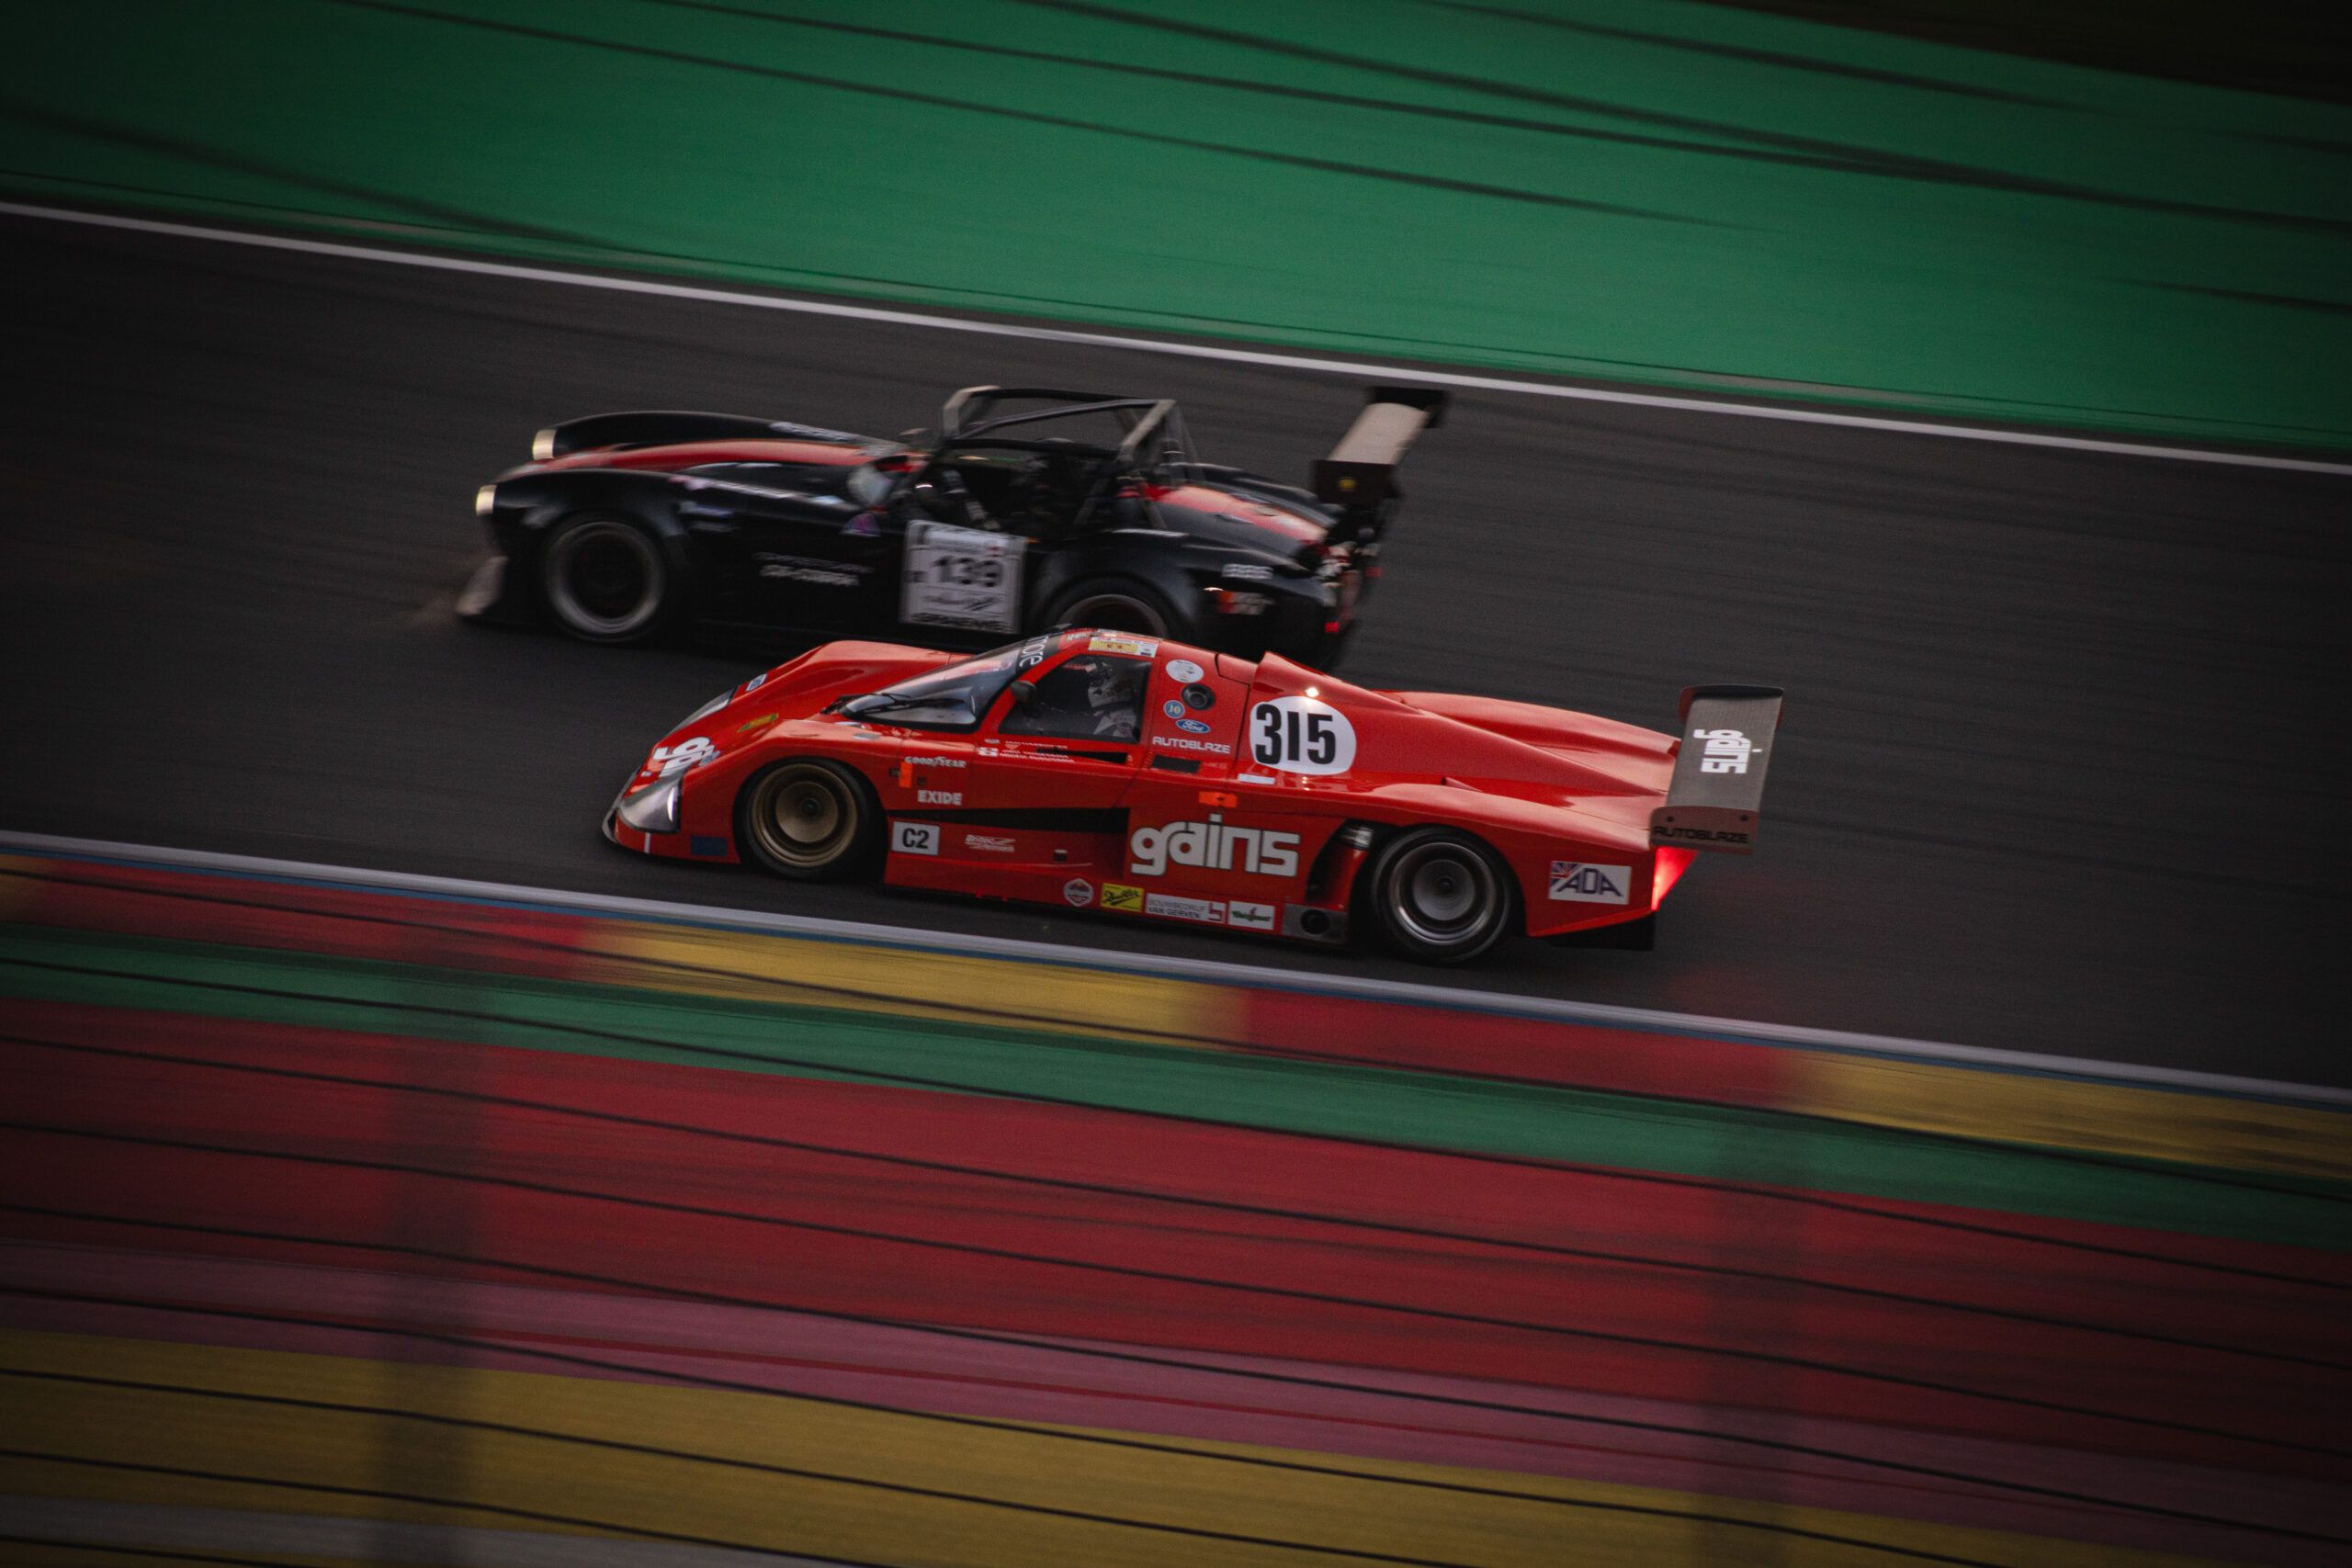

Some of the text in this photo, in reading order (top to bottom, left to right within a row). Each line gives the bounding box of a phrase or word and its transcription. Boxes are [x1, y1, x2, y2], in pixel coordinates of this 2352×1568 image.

[1152, 736, 1231, 754] AUTOBLAZE
[1255, 704, 1336, 764] 315
[904, 756, 967, 769] GOODYEAR
[1693, 728, 1762, 773] gains
[917, 790, 963, 806] EXIDE
[902, 827, 929, 851] C2
[1130, 813, 1300, 877] gains
[1654, 826, 1749, 844] AUTOBLAZE
[1556, 868, 1623, 897] ADA
